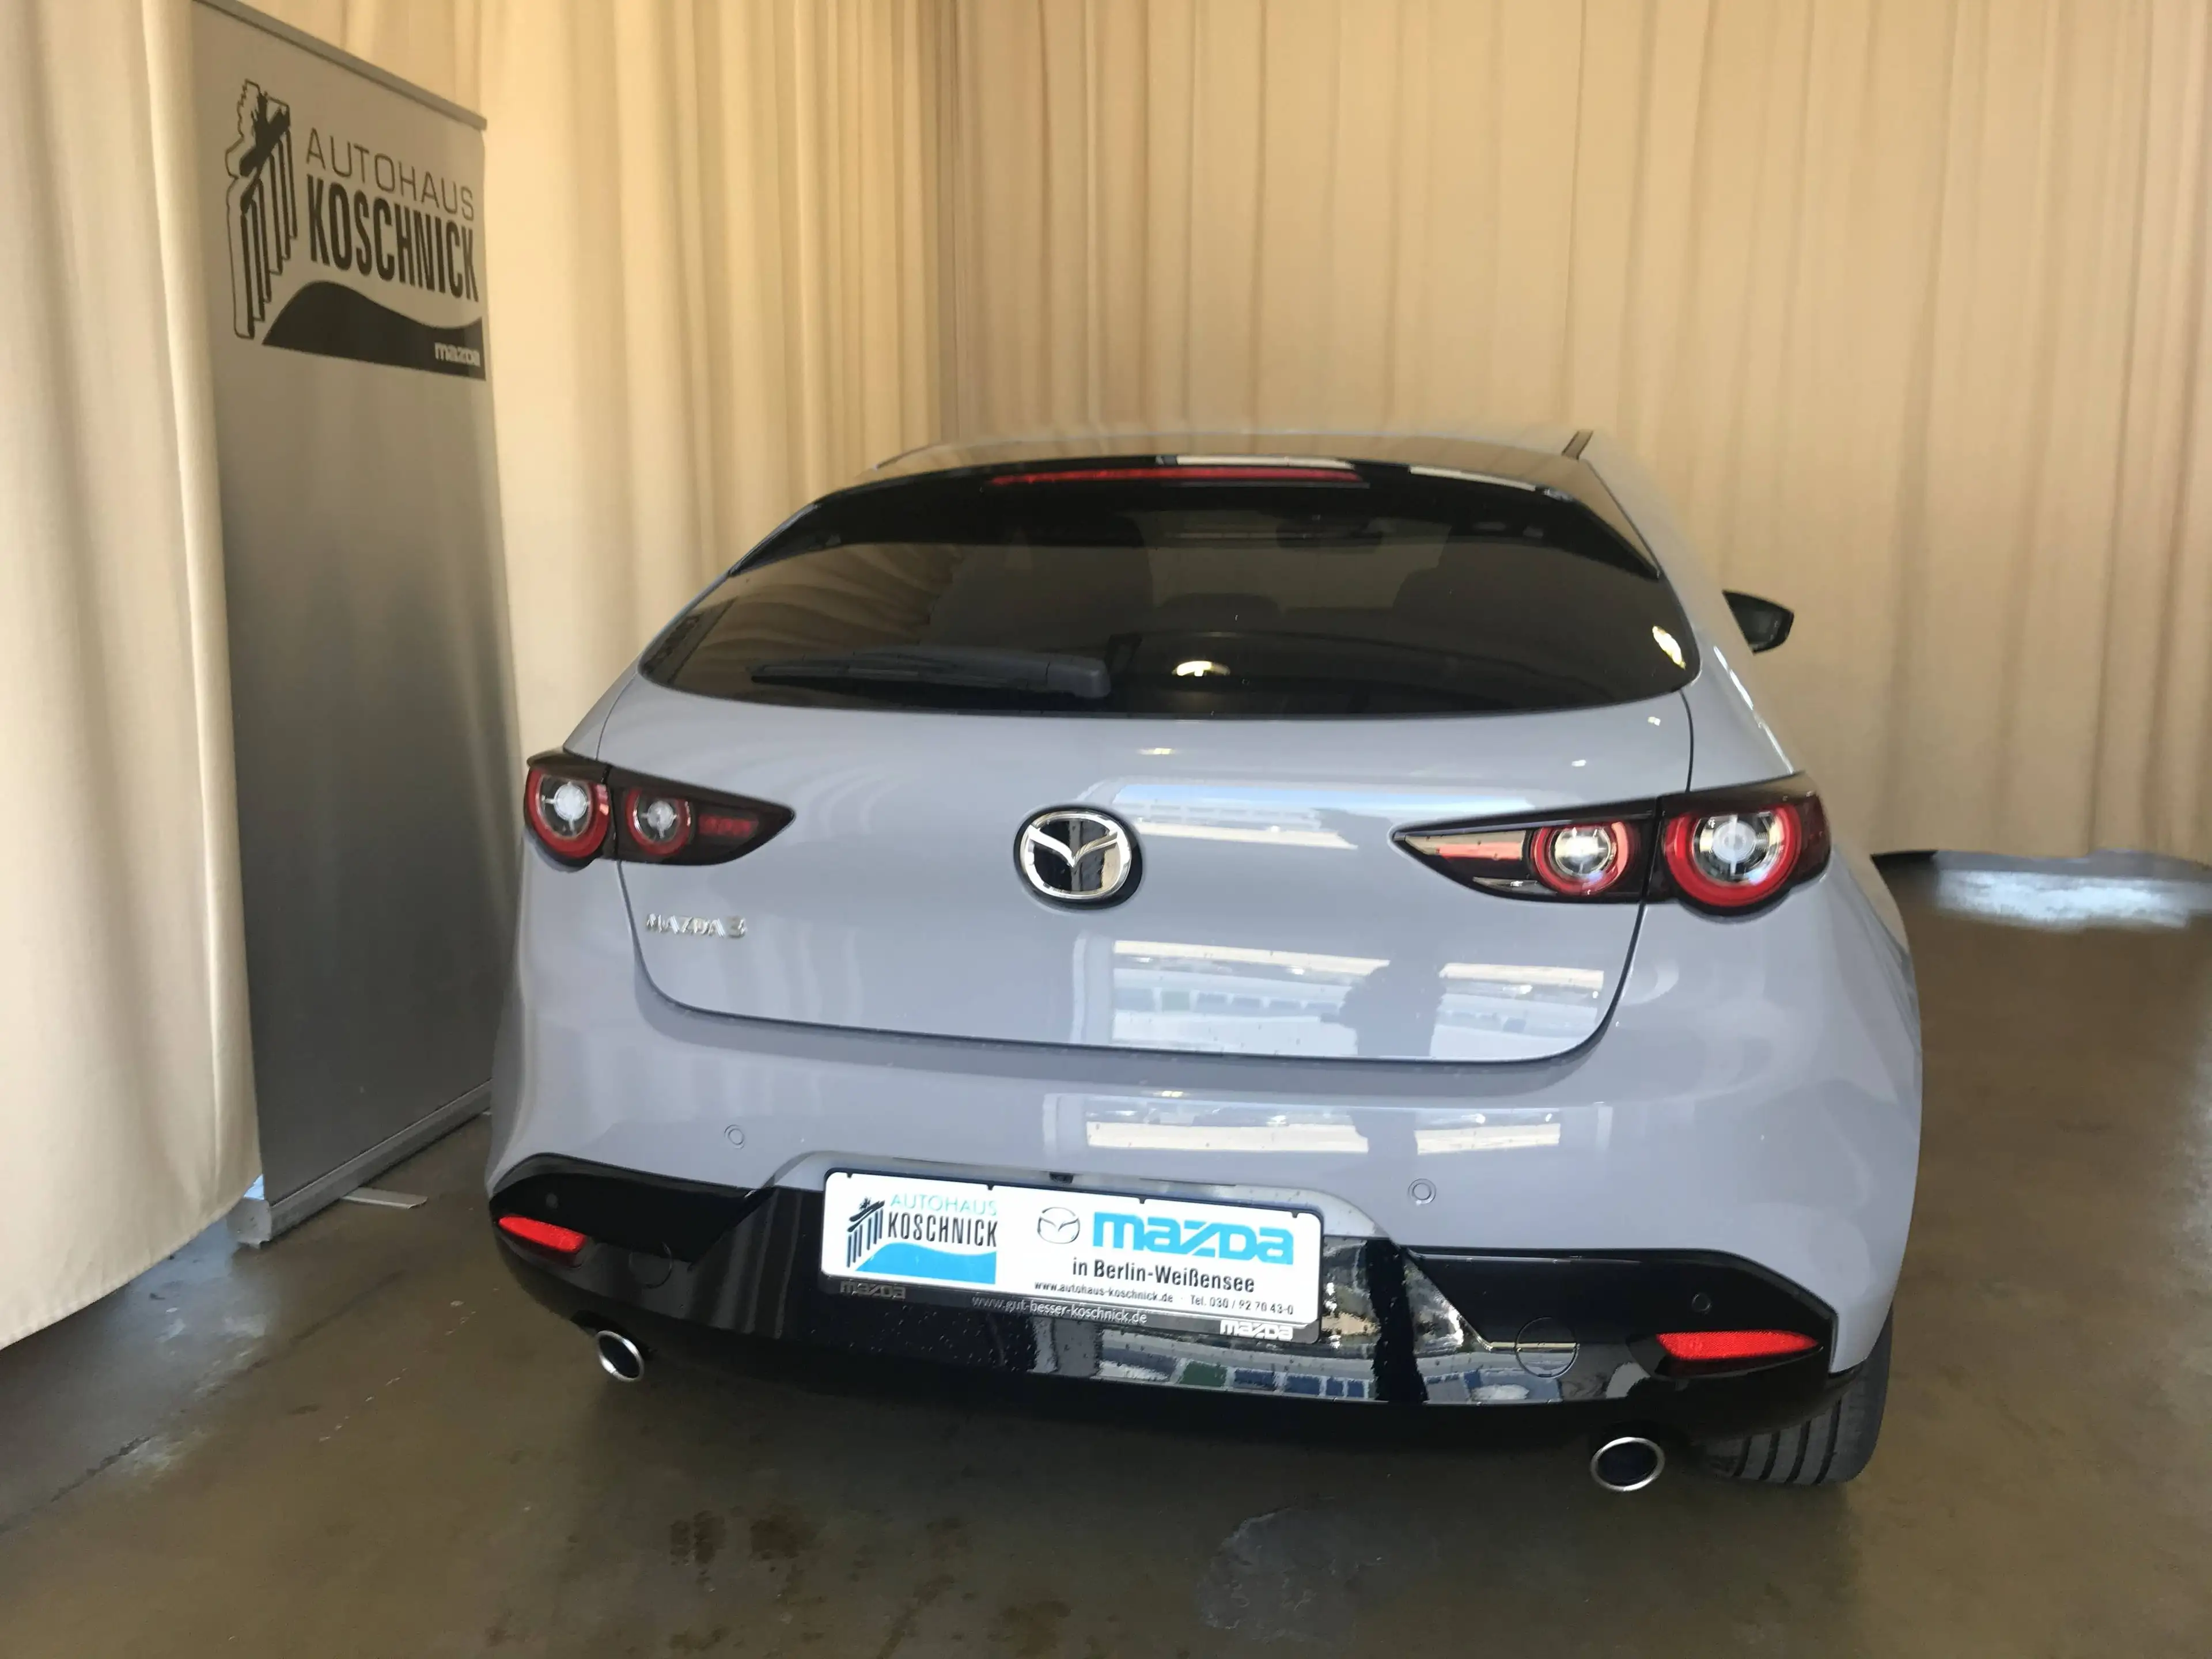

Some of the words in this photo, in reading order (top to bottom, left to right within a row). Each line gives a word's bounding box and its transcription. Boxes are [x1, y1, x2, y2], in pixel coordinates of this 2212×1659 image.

[306, 127, 475, 222] AUTOHAUS
[306, 173, 479, 302] KOSCHNICK
[889, 1193, 998, 1216] AUTOHAUS
[887, 1211, 998, 1248] KOSCHNICK
[1072, 1256, 1088, 1277] in
[1093, 1259, 1255, 1293] Berlin-Weißensee
[1034, 1280, 1173, 1304] www.autohaus-koschnick.de
[1190, 1294, 1207, 1307] Tel.
[1210, 1297, 1229, 1309] 030
